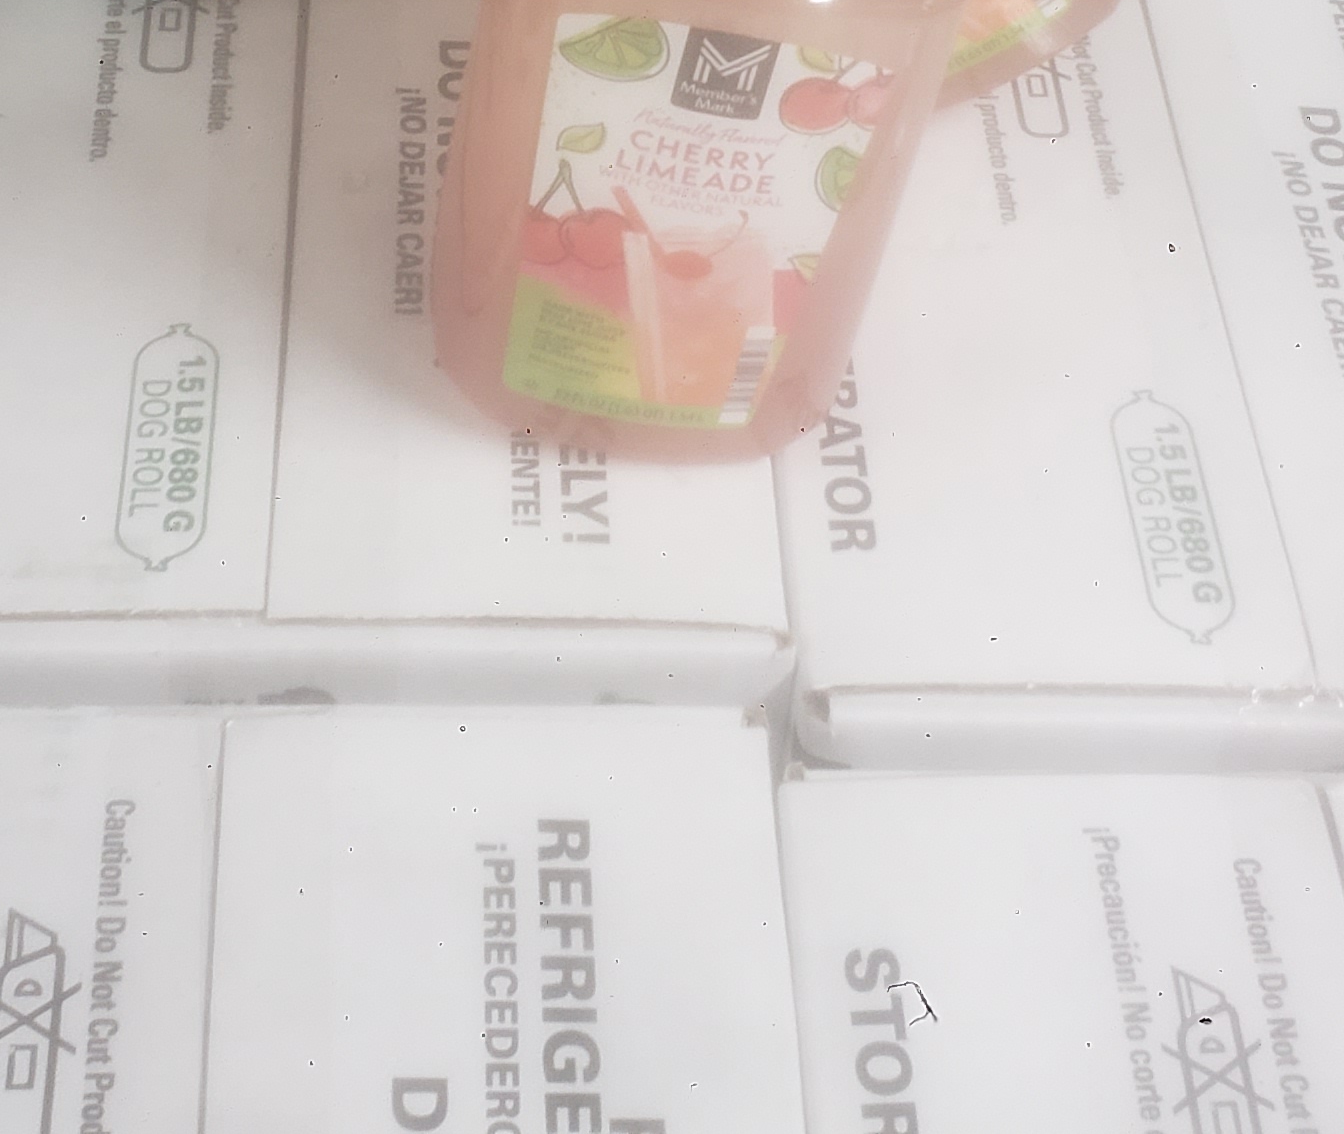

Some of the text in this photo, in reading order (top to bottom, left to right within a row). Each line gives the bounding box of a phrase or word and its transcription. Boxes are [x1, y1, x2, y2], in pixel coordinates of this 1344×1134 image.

[105, 20, 126, 34] el
[212, 23, 238, 82] Product
[97, 38, 124, 105] producto
[680, 80, 757, 105] Member's
[695, 96, 736, 114] Mark
[1075, 62, 1098, 87] Cut
[89, 108, 118, 162] dentro.
[629, 128, 775, 171] CHERRY
[973, 101, 1007, 170] producto
[1081, 89, 1111, 146] Product
[396, 140, 426, 226] DEJAR
[615, 148, 775, 195] LIMEADE
[394, 234, 424, 316] CAER!
[1292, 204, 1341, 290] DEJAR
[128, 379, 173, 518] DOG ROLL
[162, 355, 207, 532] 1.5 LB/680 G
[1126, 446, 1183, 588] DOG ROLL
[1153, 422, 1224, 606] 1.5 LB/680 G
[84, 798, 136, 1068] Caution! Do Not Cut
[1120, 1000, 1152, 1043] No
[1231, 856, 1312, 1122] Caution! Do Not Cut
[1127, 1047, 1165, 1122] corte
